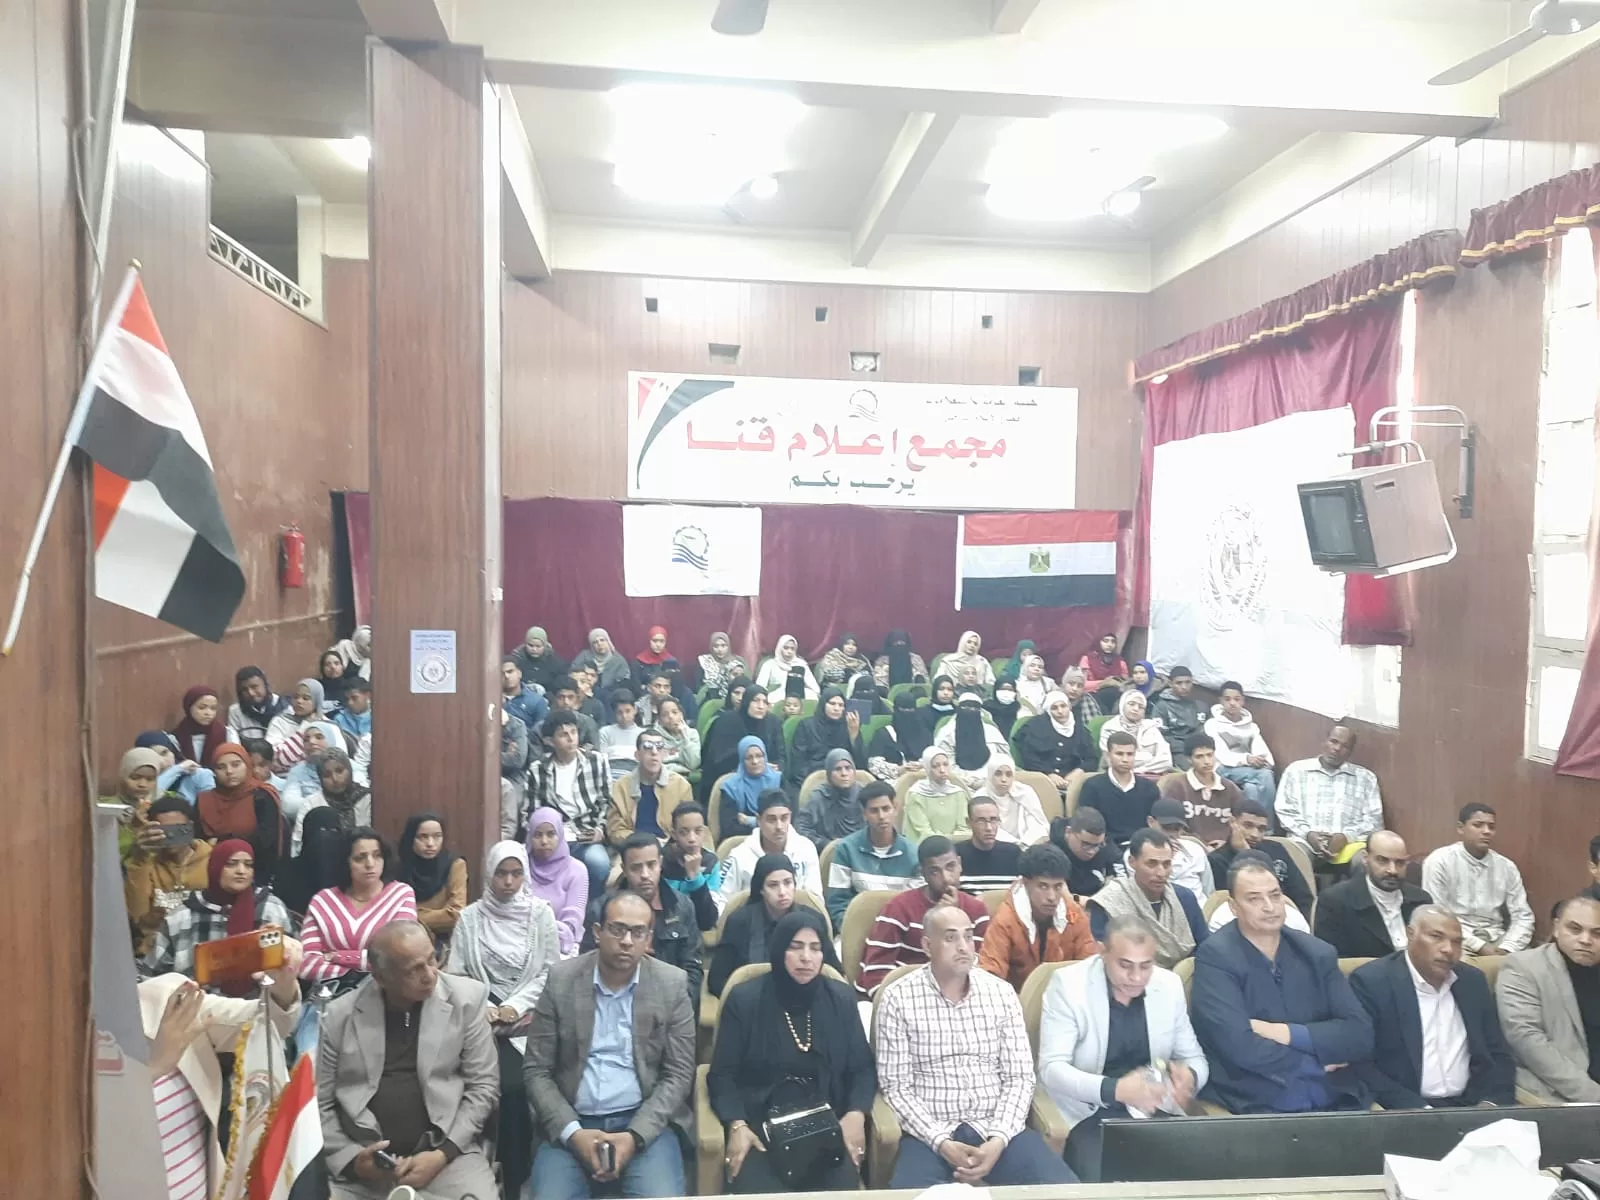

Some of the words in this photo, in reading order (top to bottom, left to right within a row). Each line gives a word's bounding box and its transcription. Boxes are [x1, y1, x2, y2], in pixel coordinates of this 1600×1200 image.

[686, 416, 775, 452] قنا
[787, 422, 898, 467] إعلام
[906, 434, 1007, 472] مجمع
[789, 470, 840, 494] بكم
[849, 477, 915, 496] يرحب
